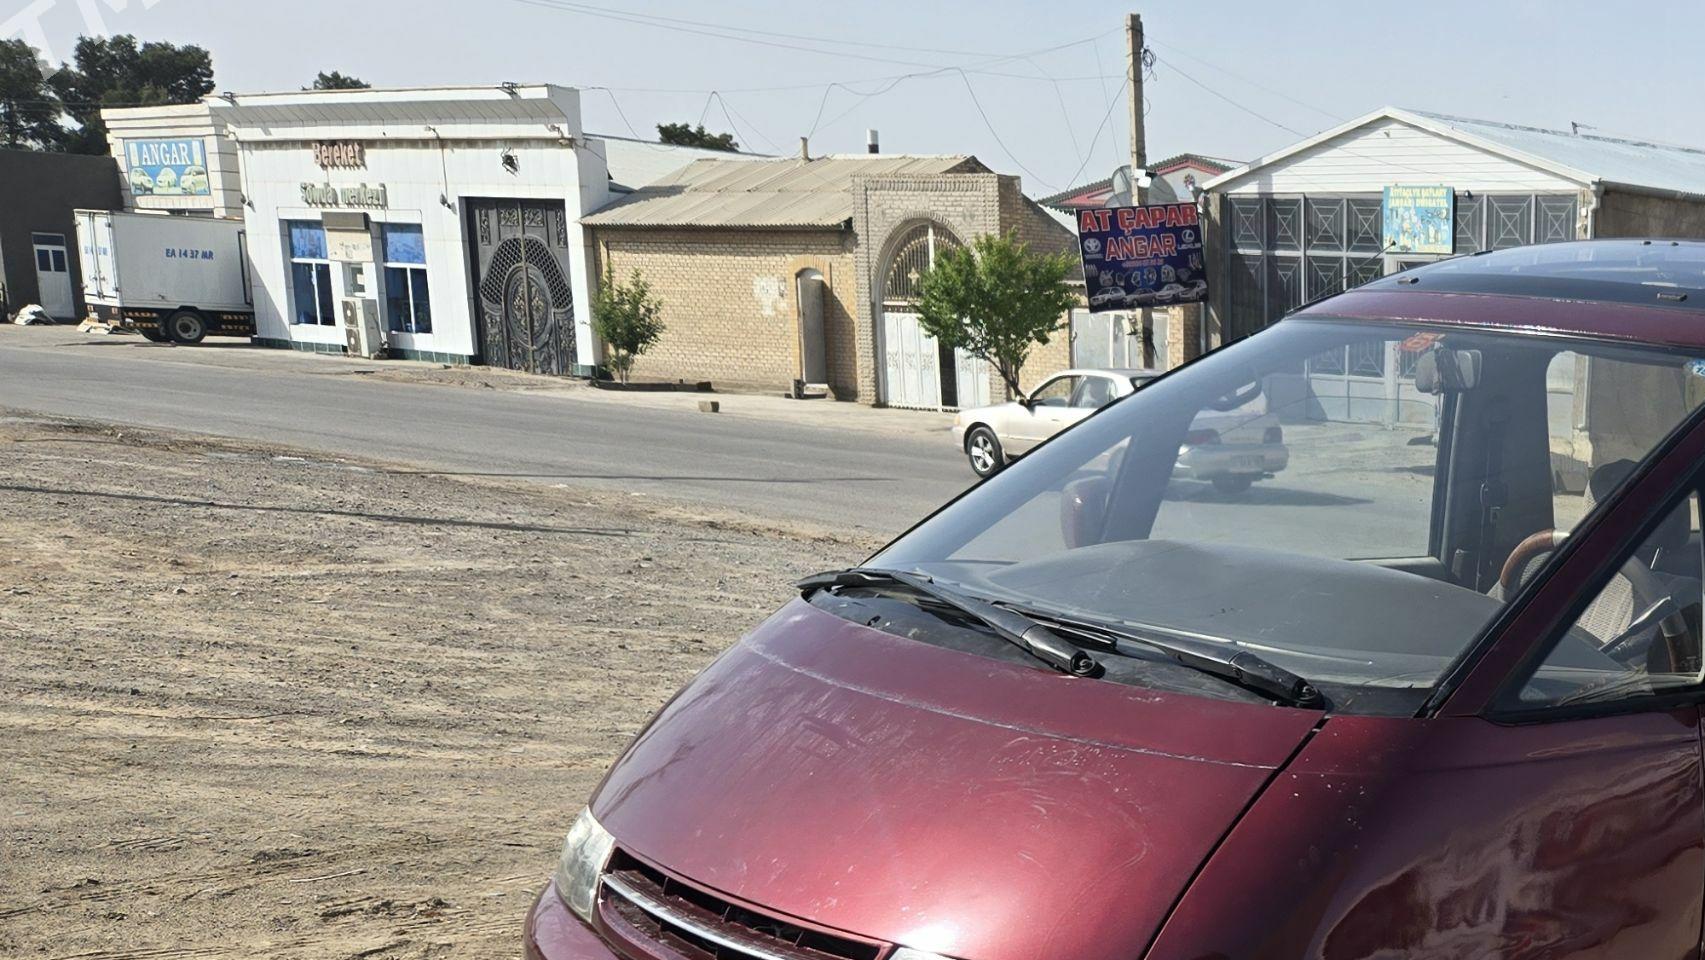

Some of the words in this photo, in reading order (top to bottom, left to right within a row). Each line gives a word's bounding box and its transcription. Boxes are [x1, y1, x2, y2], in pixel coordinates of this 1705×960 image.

[142, 143, 191, 166] ANGAR
[312, 142, 364, 168] Bereket
[1081, 209, 1112, 232] AT
[1118, 204, 1198, 236] ÇAPAR
[165, 248, 176, 258] EA
[179, 248, 188, 258] 14
[201, 249, 214, 260] MR
[1105, 233, 1177, 261] ANGAR
